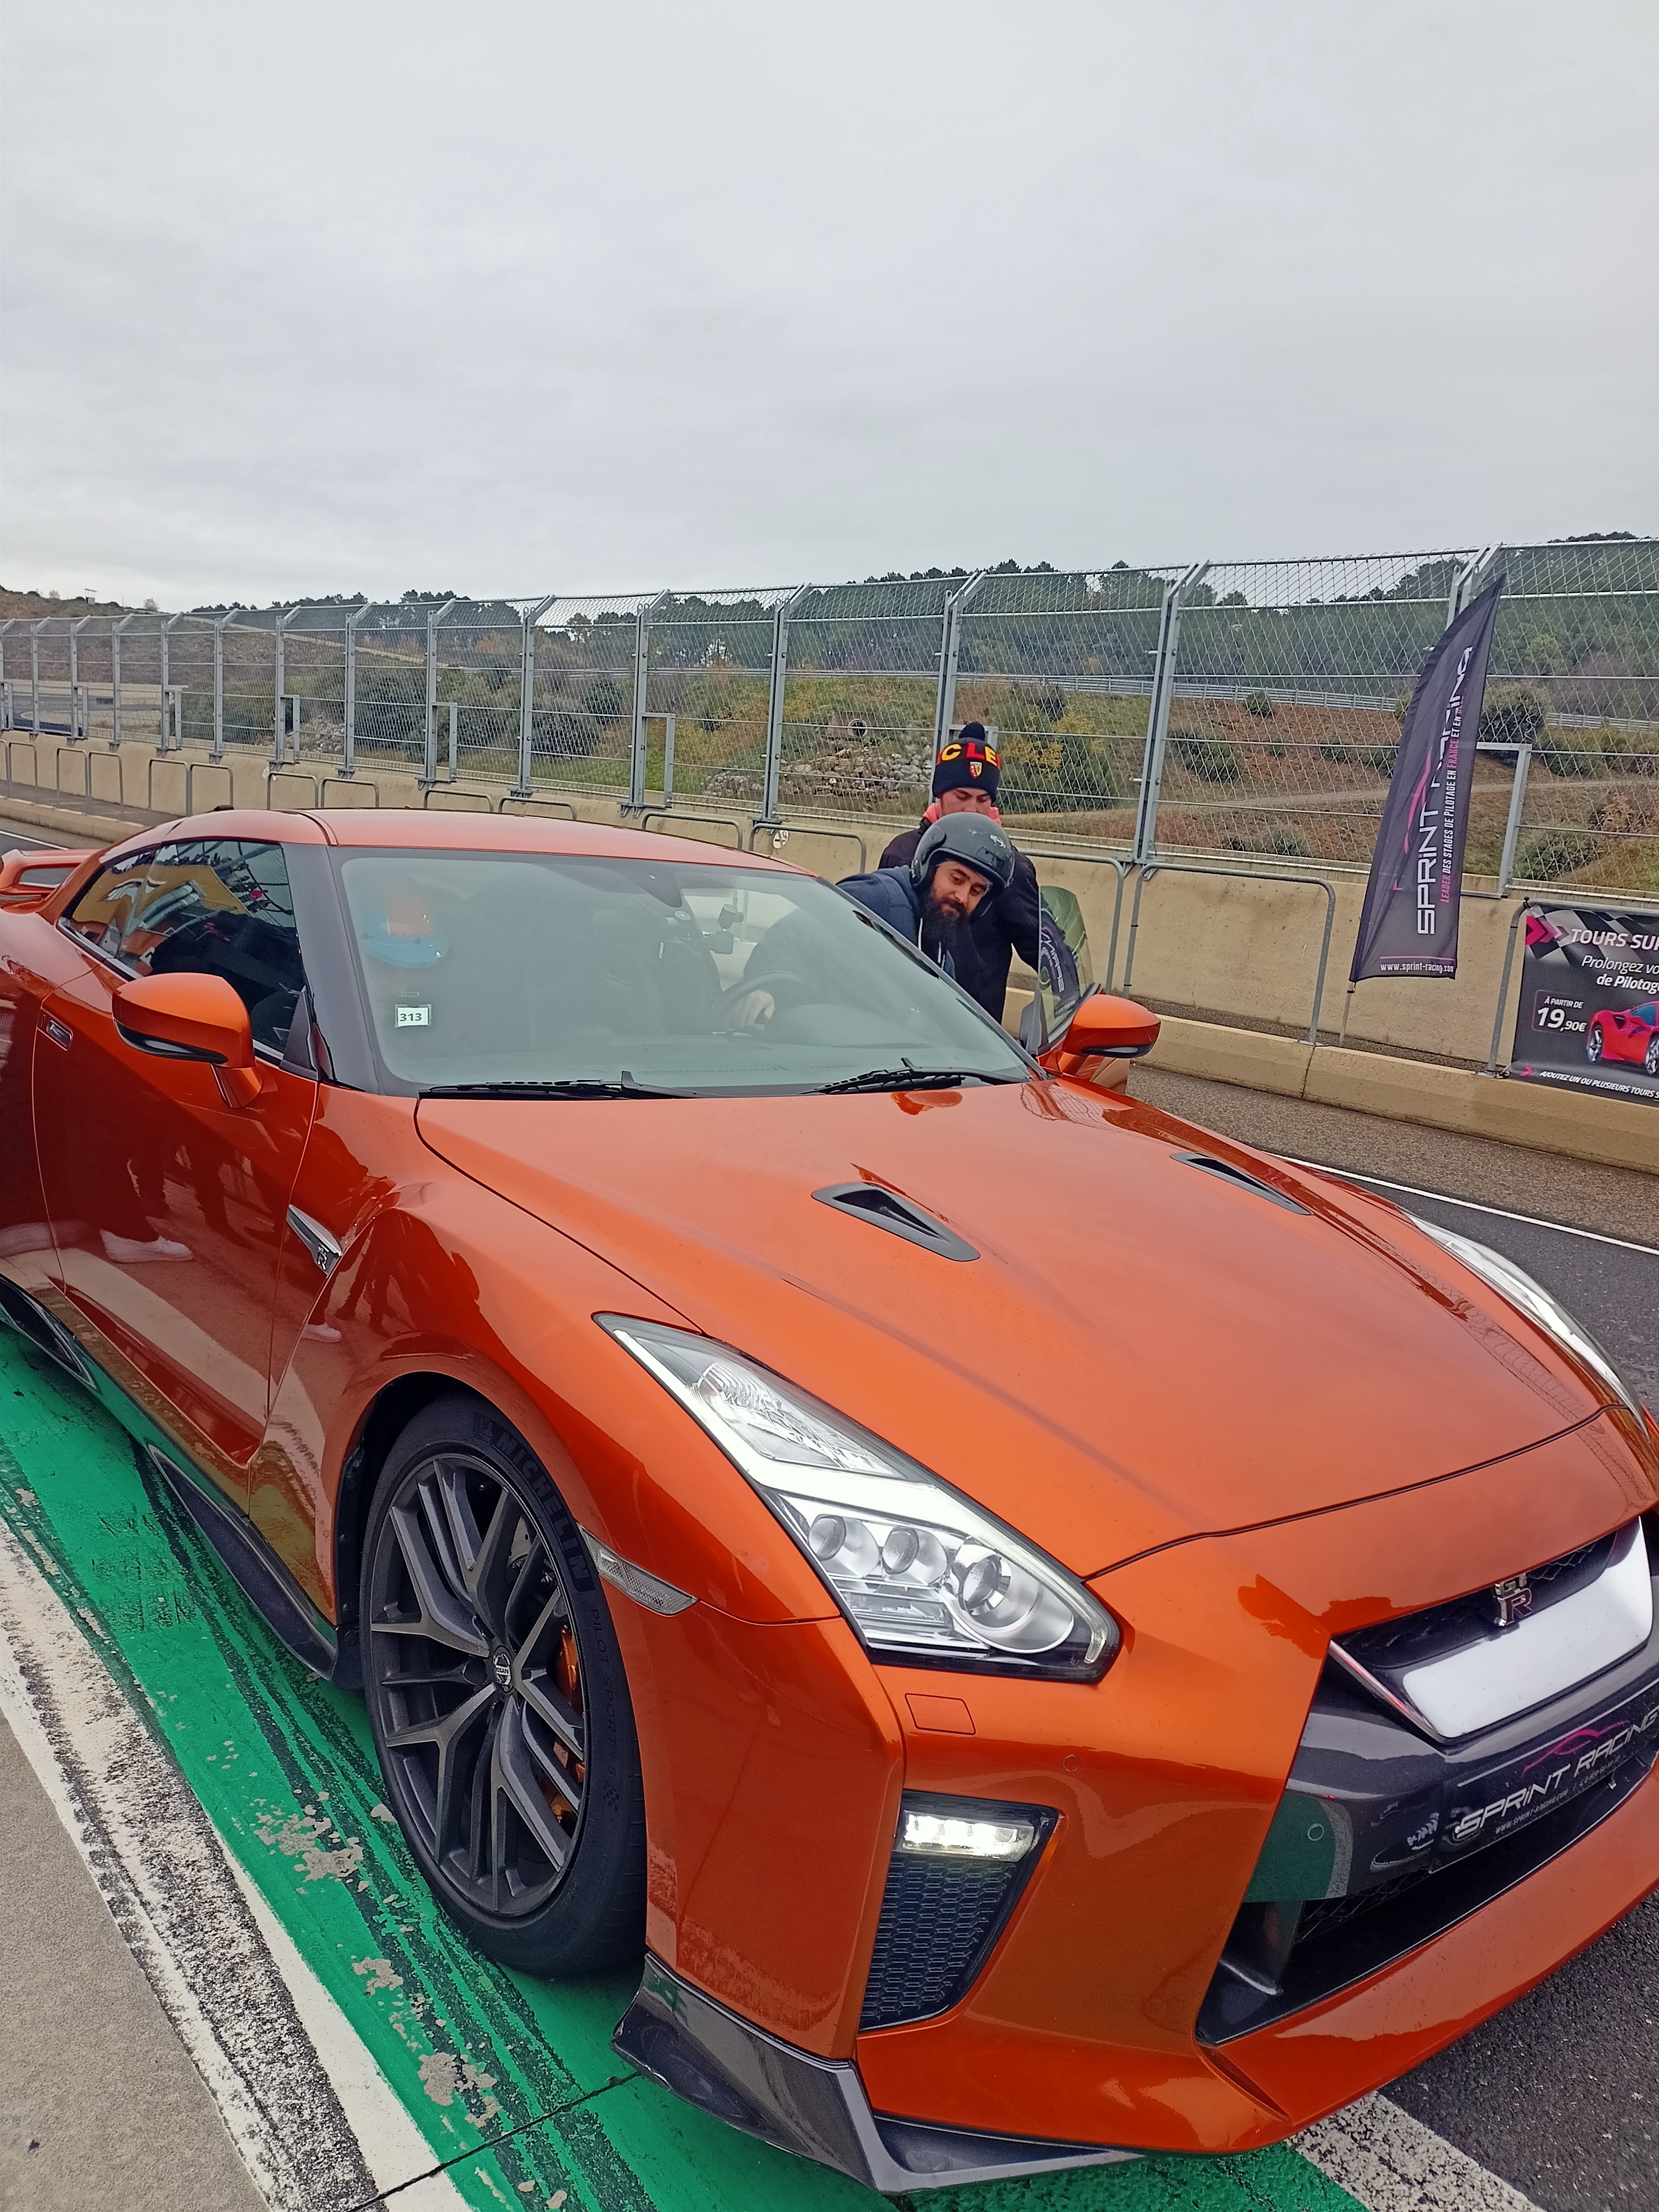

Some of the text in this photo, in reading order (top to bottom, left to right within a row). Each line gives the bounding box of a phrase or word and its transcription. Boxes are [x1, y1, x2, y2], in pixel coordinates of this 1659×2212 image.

[1451, 727, 1460, 738] ET
[1447, 739, 1459, 769] FRANCE
[1447, 770, 1457, 780] EN
[1443, 817, 1454, 829] DE
[1443, 830, 1453, 858] STAGES
[1442, 859, 1452, 874] DES
[1440, 874, 1451, 904] LEADER
[1571, 928, 1629, 947] TOURS
[1581, 954, 1644, 974] Prolongez
[1596, 973, 1659, 994] de Pilotag
[1550, 998, 1574, 1008] PARTIR
[399, 1013, 422, 1021] 313
[1539, 1071, 1571, 1081] AJOUTEZ
[1568, 1075, 1582, 1083] UN
[1580, 1077, 1593, 1086] OU
[1591, 1079, 1631, 1093] PLUSIEURS
[1630, 1087, 1655, 1098] TOURS
[495, 1431, 590, 1579] MICHELIN
